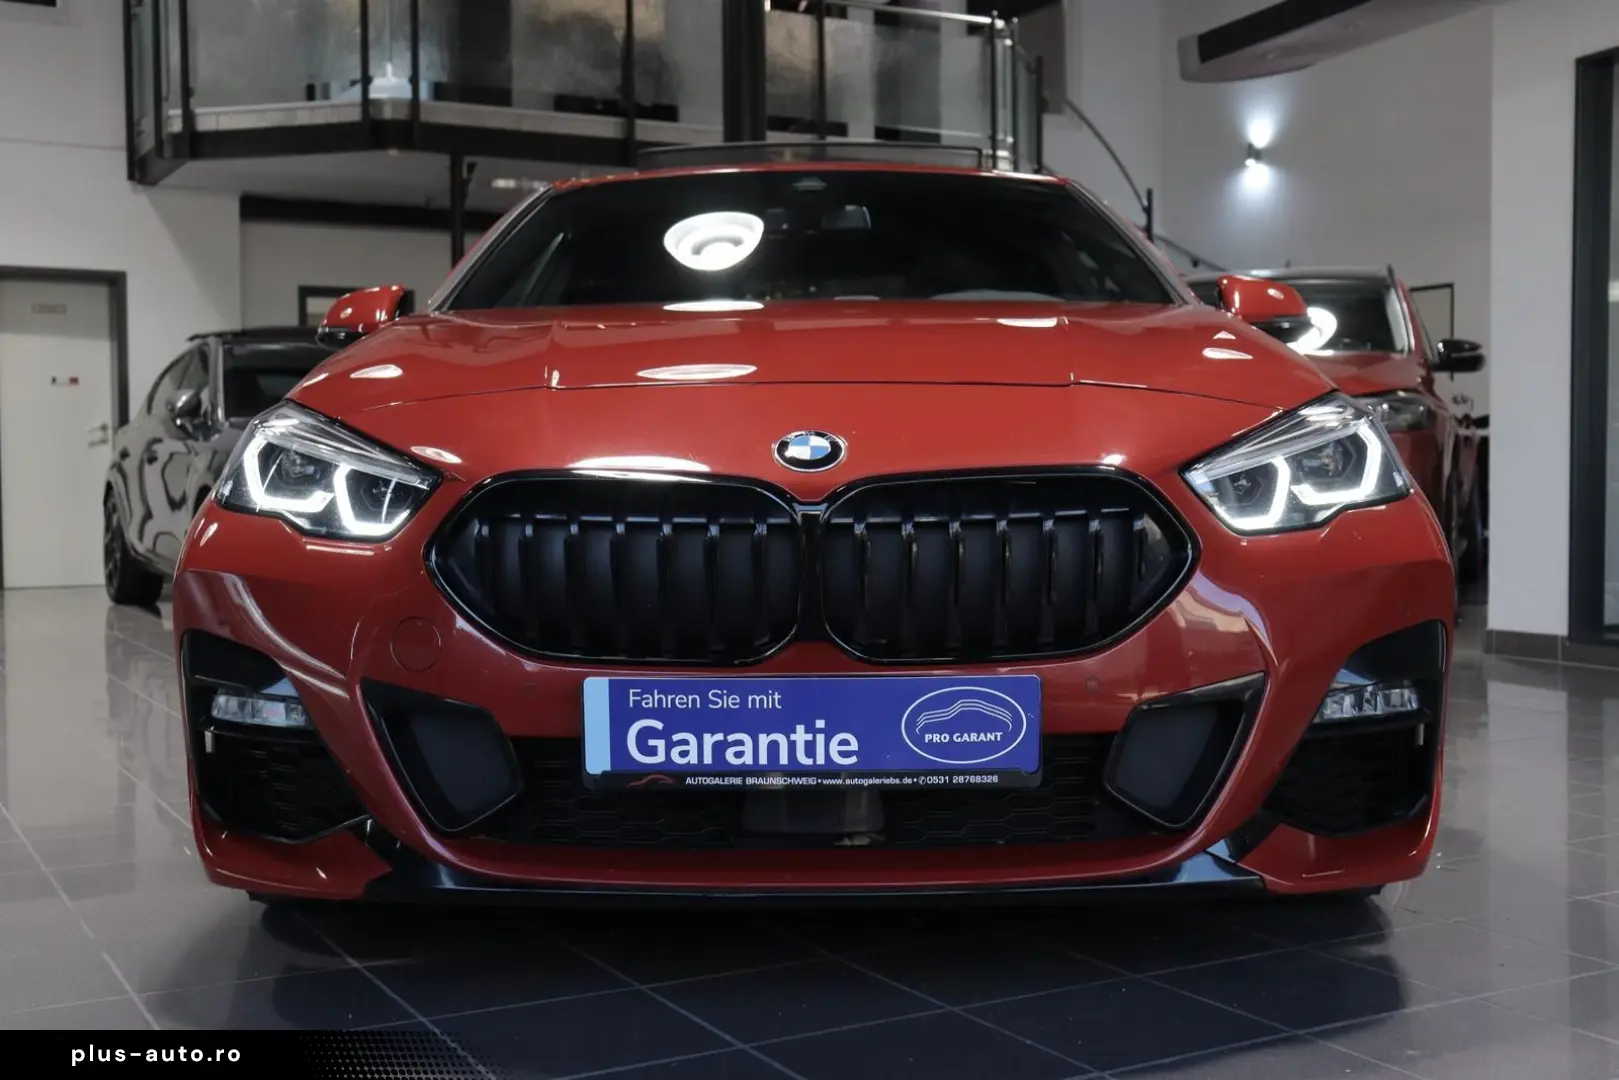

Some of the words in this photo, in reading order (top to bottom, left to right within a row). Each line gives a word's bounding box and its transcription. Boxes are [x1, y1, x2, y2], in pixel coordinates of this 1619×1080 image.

[628, 688, 700, 709] Fahren
[708, 688, 740, 709] Sie
[748, 689, 782, 709] mit
[626, 718, 859, 765] Garantie
[924, 733, 949, 743] PRO
[953, 732, 1003, 743] GARANT
[685, 776, 743, 785] AUTOGALERIE
